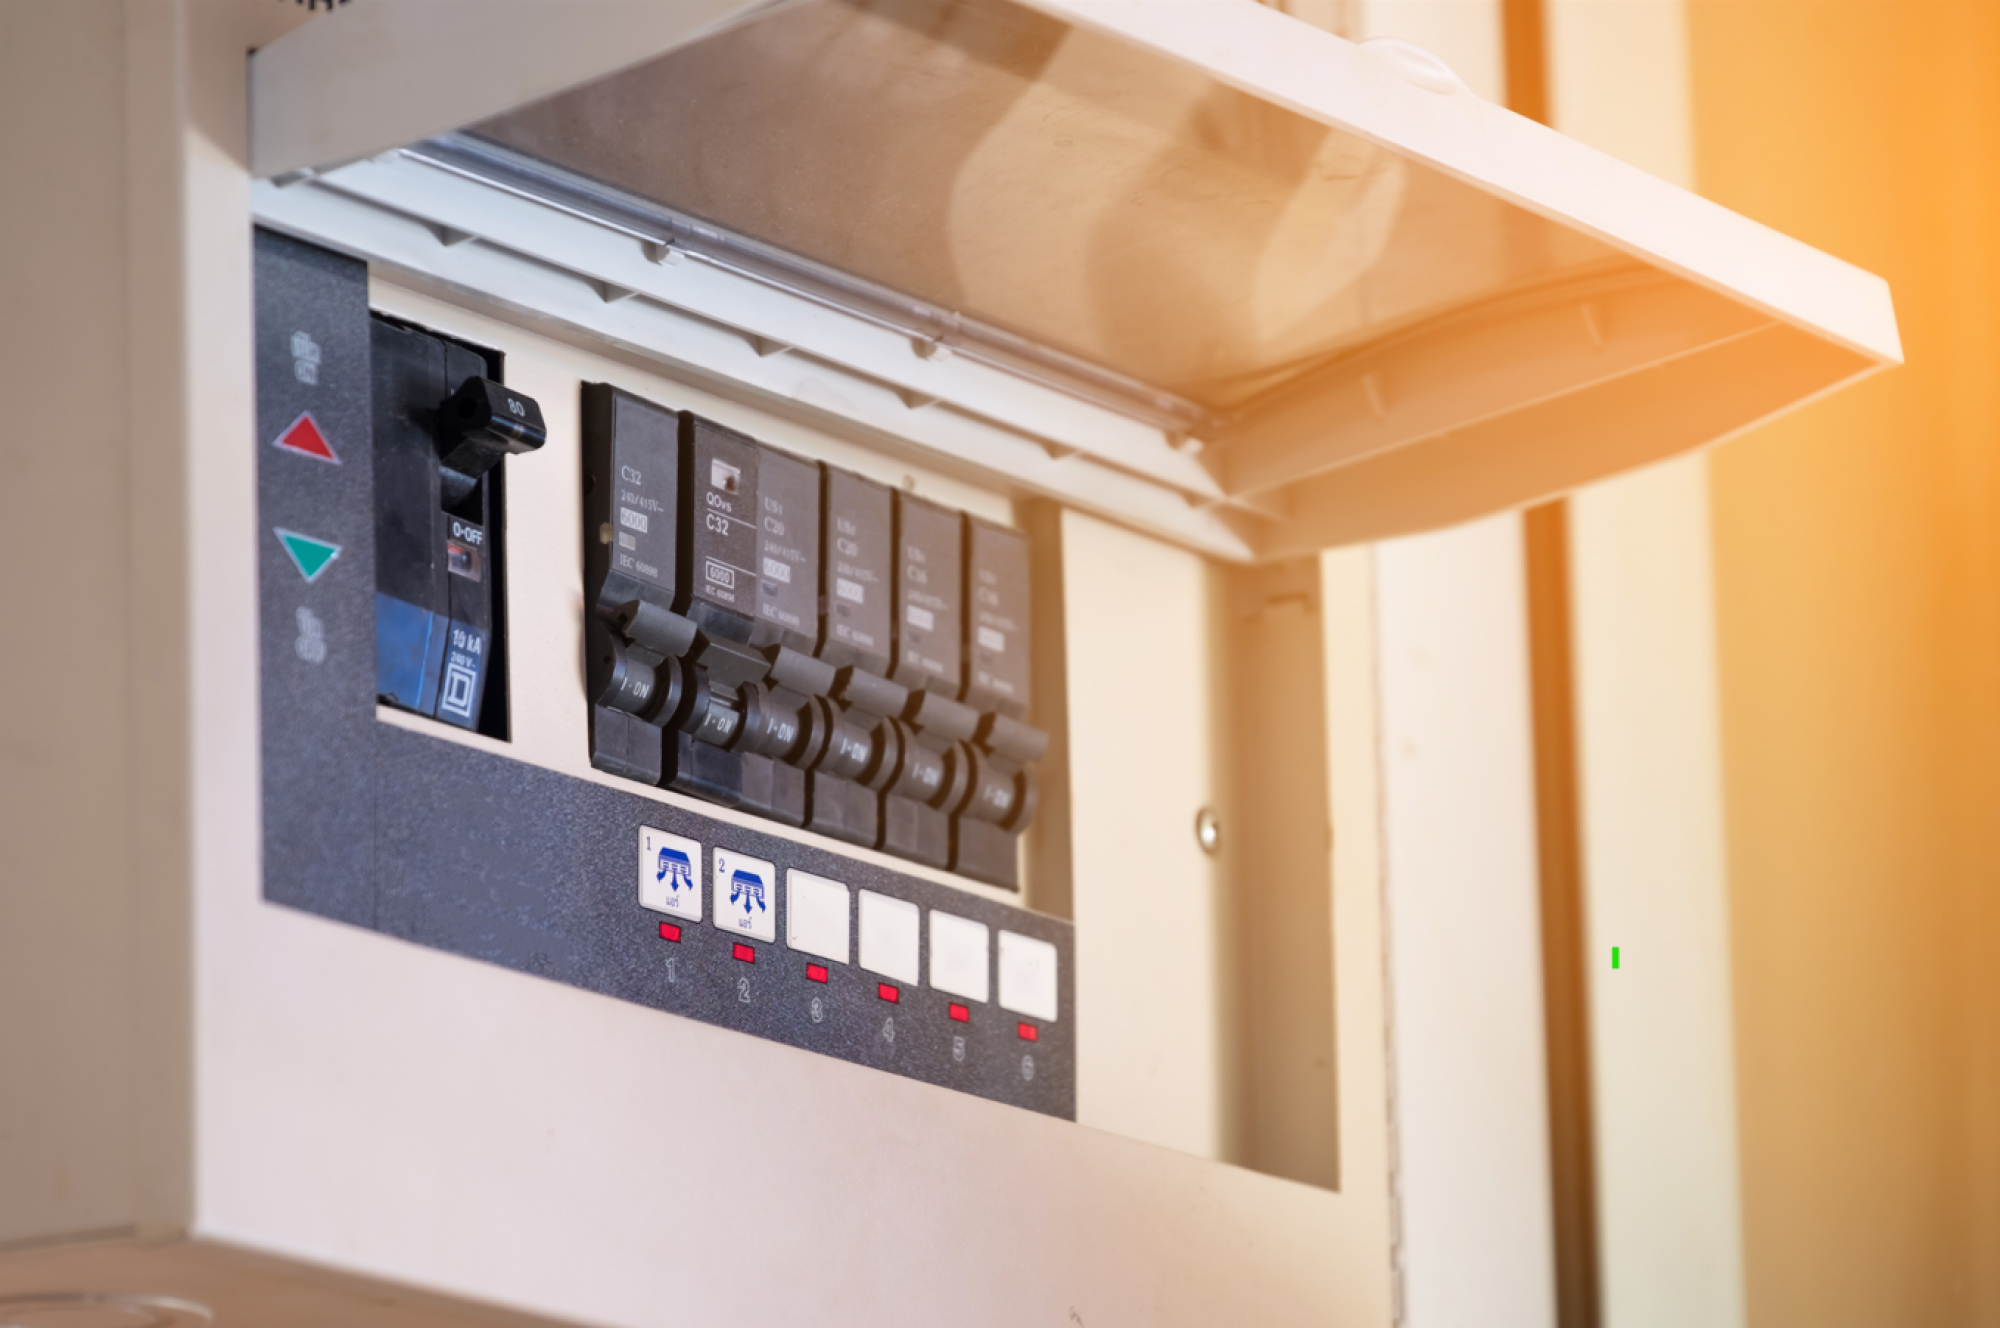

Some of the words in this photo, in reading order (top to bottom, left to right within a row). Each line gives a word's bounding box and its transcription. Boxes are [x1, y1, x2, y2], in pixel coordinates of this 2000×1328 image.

[507, 397, 525, 417] 80
[621, 465, 642, 486] C32
[706, 513, 729, 536] C32
[620, 553, 635, 569] IEC
[709, 567, 731, 584] 6000
[466, 634, 481, 655] kA
[646, 836, 651, 851] 1
[718, 858, 725, 873] 2
[665, 957, 676, 983] 1
[737, 977, 750, 1003] 2
[882, 1017, 895, 1043] 4
